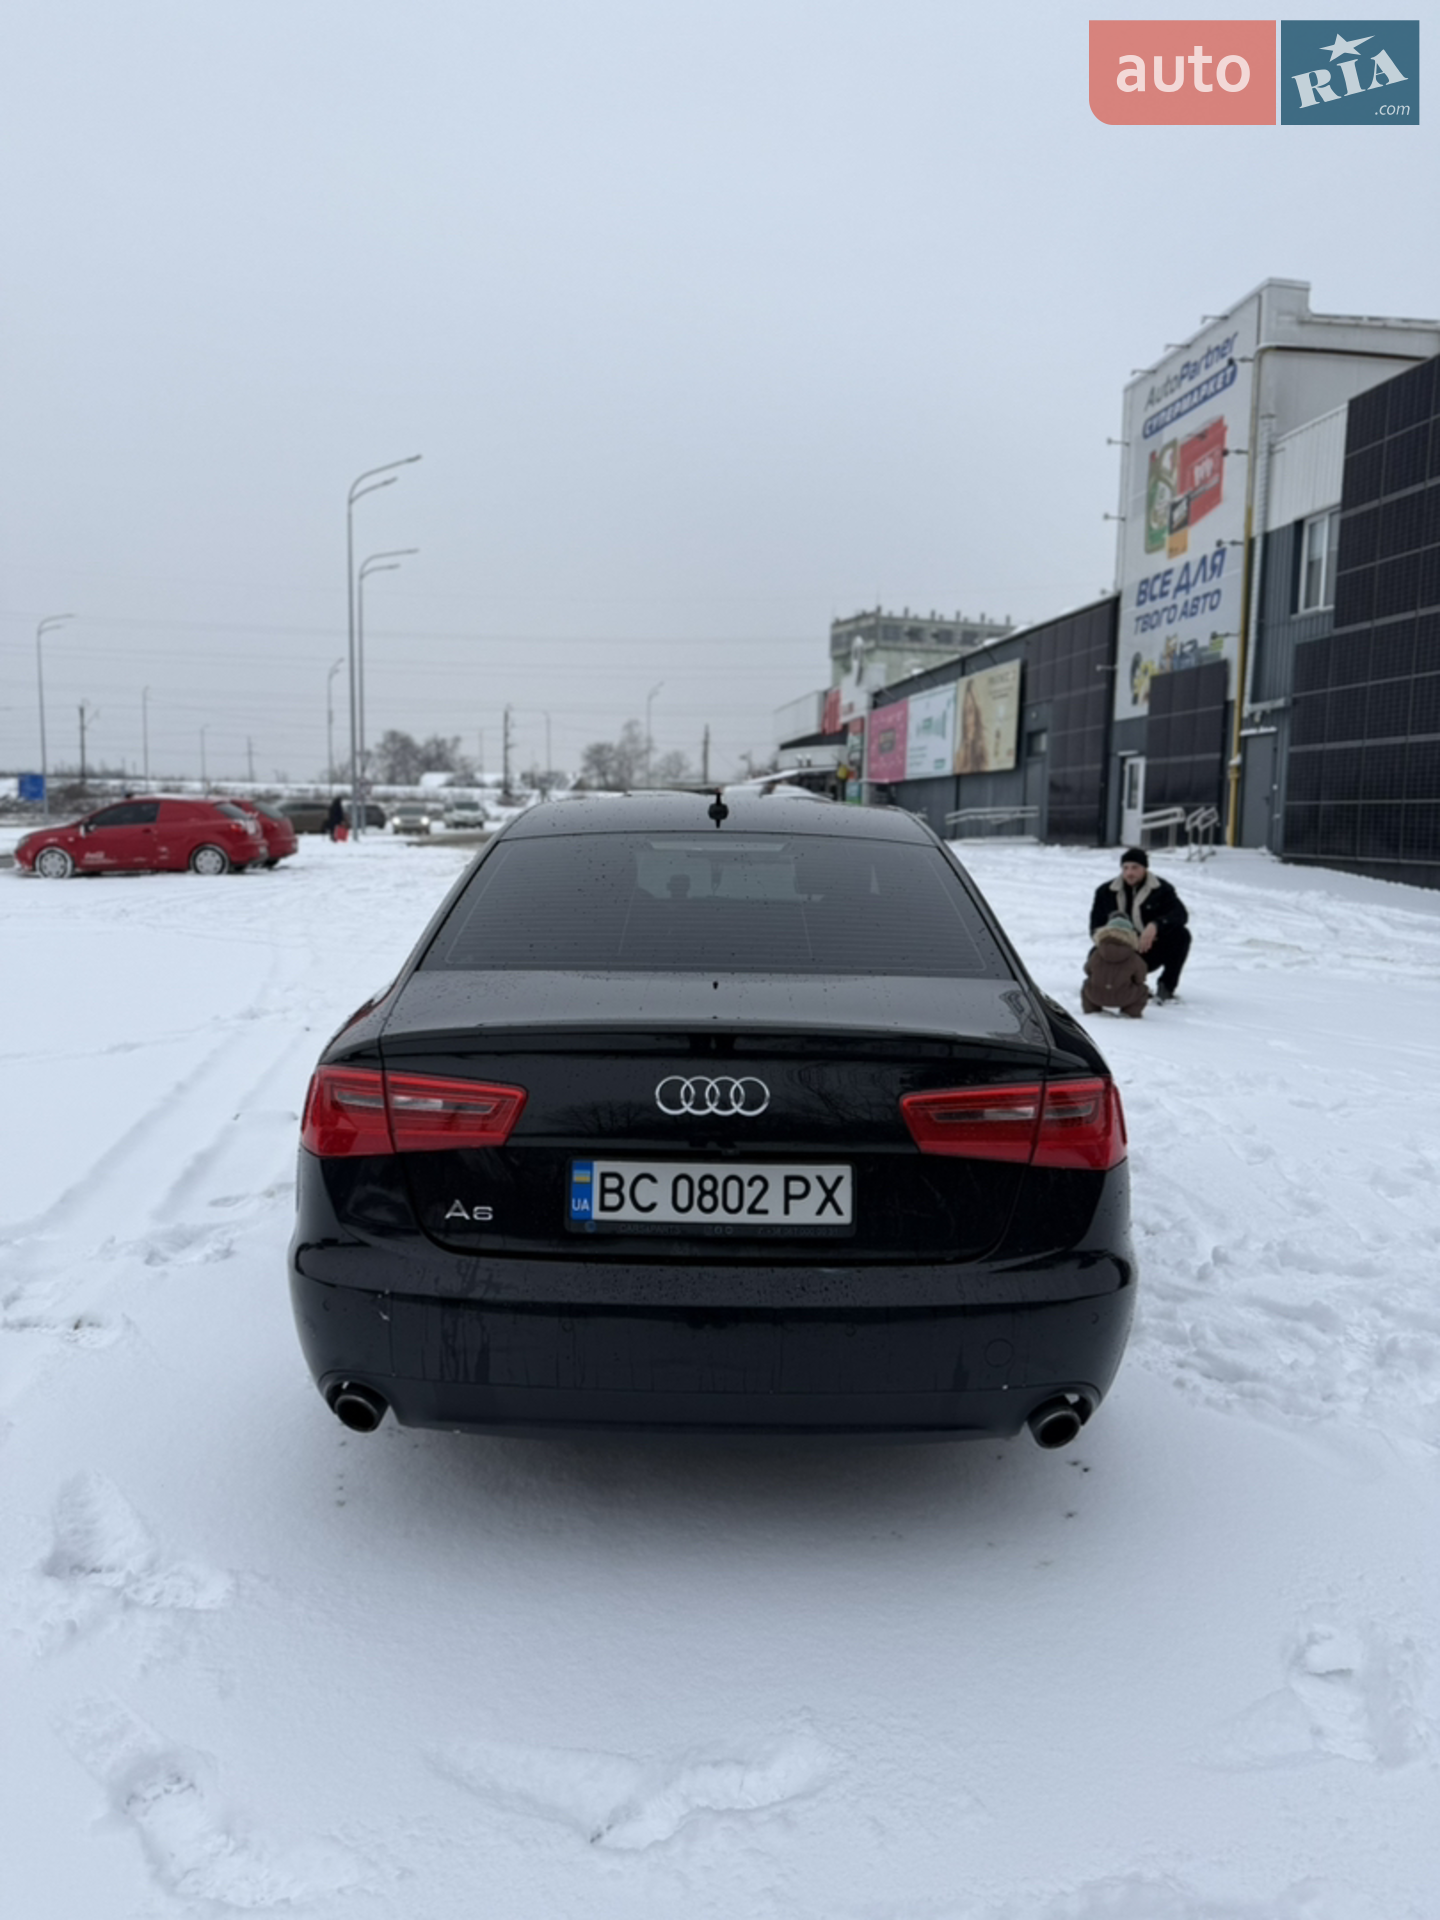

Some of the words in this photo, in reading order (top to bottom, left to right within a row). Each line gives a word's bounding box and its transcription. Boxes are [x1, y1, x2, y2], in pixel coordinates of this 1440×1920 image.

[1144, 331, 1239, 411] AutoPartner
[1135, 567, 1174, 607] ВСЕ
[1173, 547, 1227, 600] ДЛЯ
[1134, 604, 1178, 635] ТВОГО
[1178, 588, 1222, 622] АВТО
[445, 1200, 494, 1220] A6
[572, 1199, 590, 1212] UA
[598, 1171, 658, 1213] BC
[671, 1173, 769, 1215] 0802
[783, 1174, 845, 1216] PX
